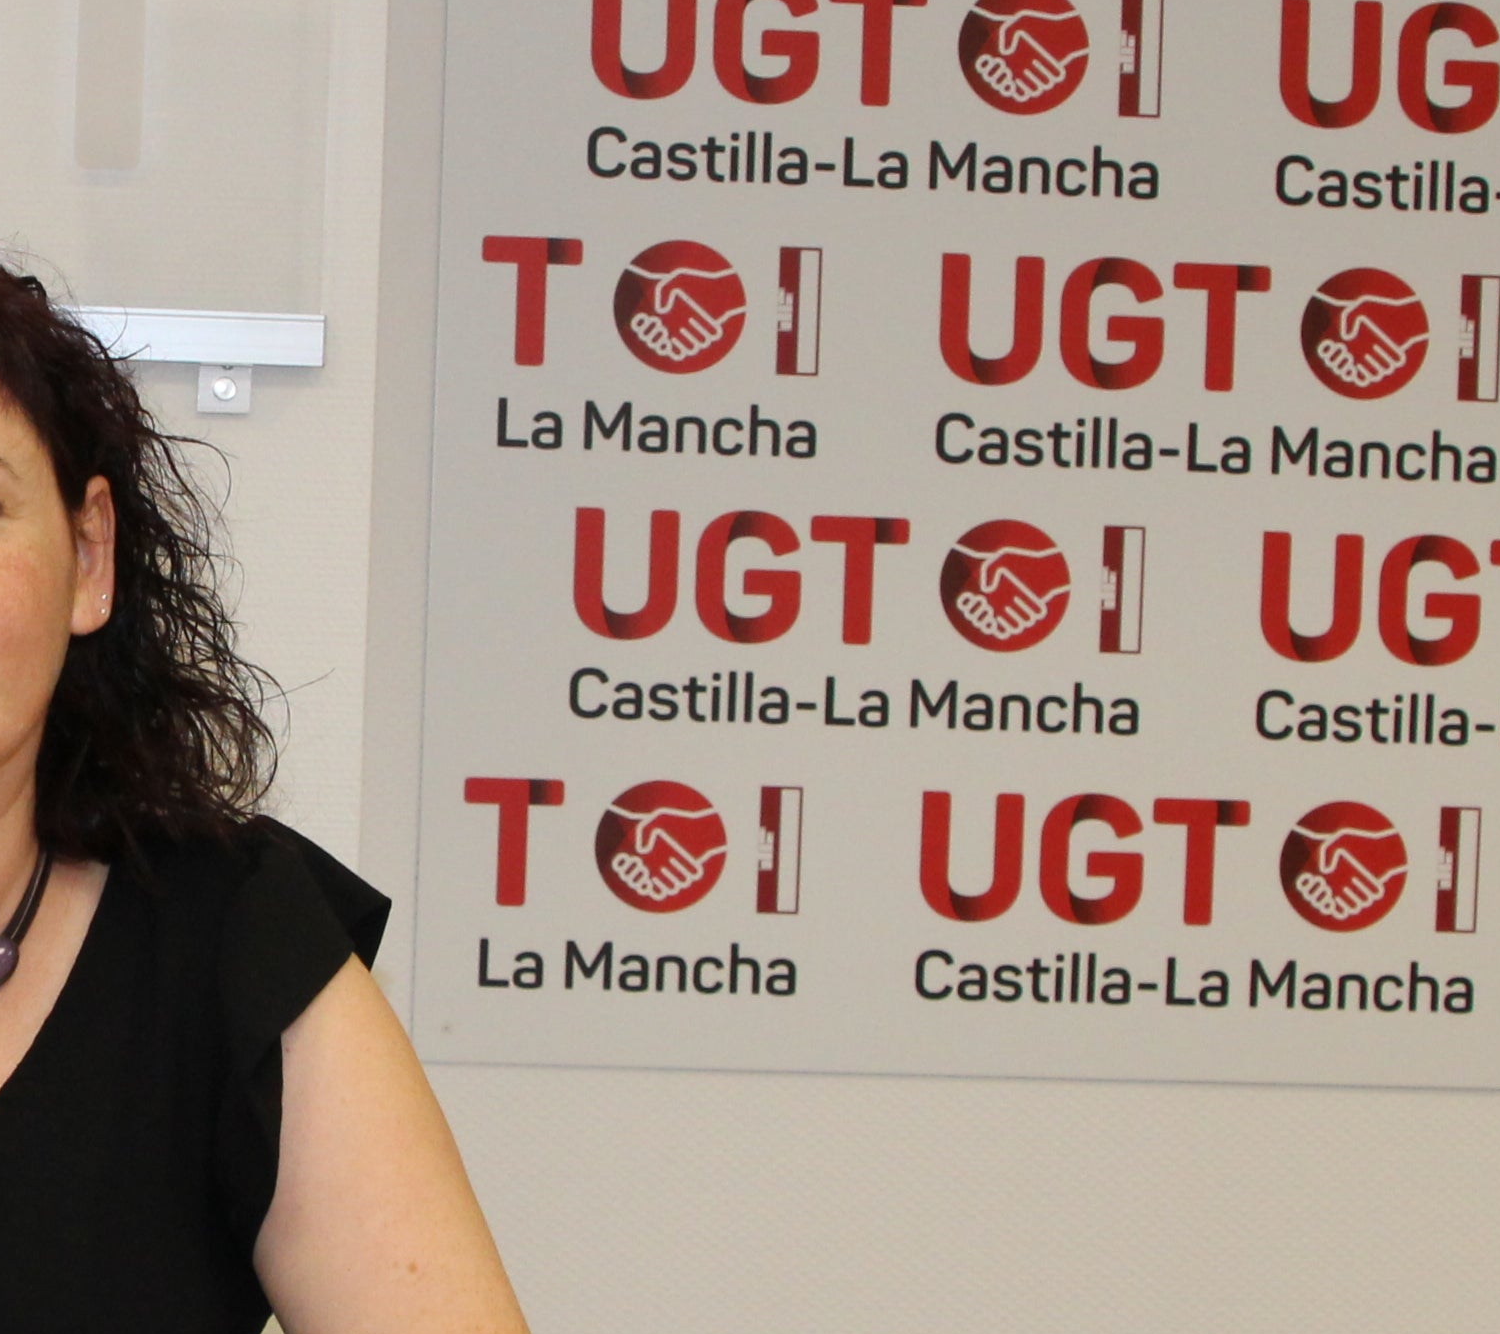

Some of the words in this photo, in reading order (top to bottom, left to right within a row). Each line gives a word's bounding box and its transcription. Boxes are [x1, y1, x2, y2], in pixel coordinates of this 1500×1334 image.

[587, 127, 908, 189] Castilla-La
[929, 141, 1158, 200] Mancha
[482, 236, 583, 366] T
[939, 253, 1271, 392] UGT
[497, 398, 562, 449] La
[584, 401, 816, 458] Mancha
[936, 413, 1250, 474] Castilla-La
[1271, 426, 1496, 483] Mancha
[573, 507, 910, 645] UGT
[569, 668, 889, 727] Castilla-La
[910, 679, 1138, 736] Mancha
[464, 777, 564, 906] T
[919, 791, 1250, 926] UGT
[478, 938, 543, 989] La
[565, 940, 796, 996] Mancha
[915, 949, 1229, 1007] Castilla-La
[1249, 959, 1473, 1014] Mancha
